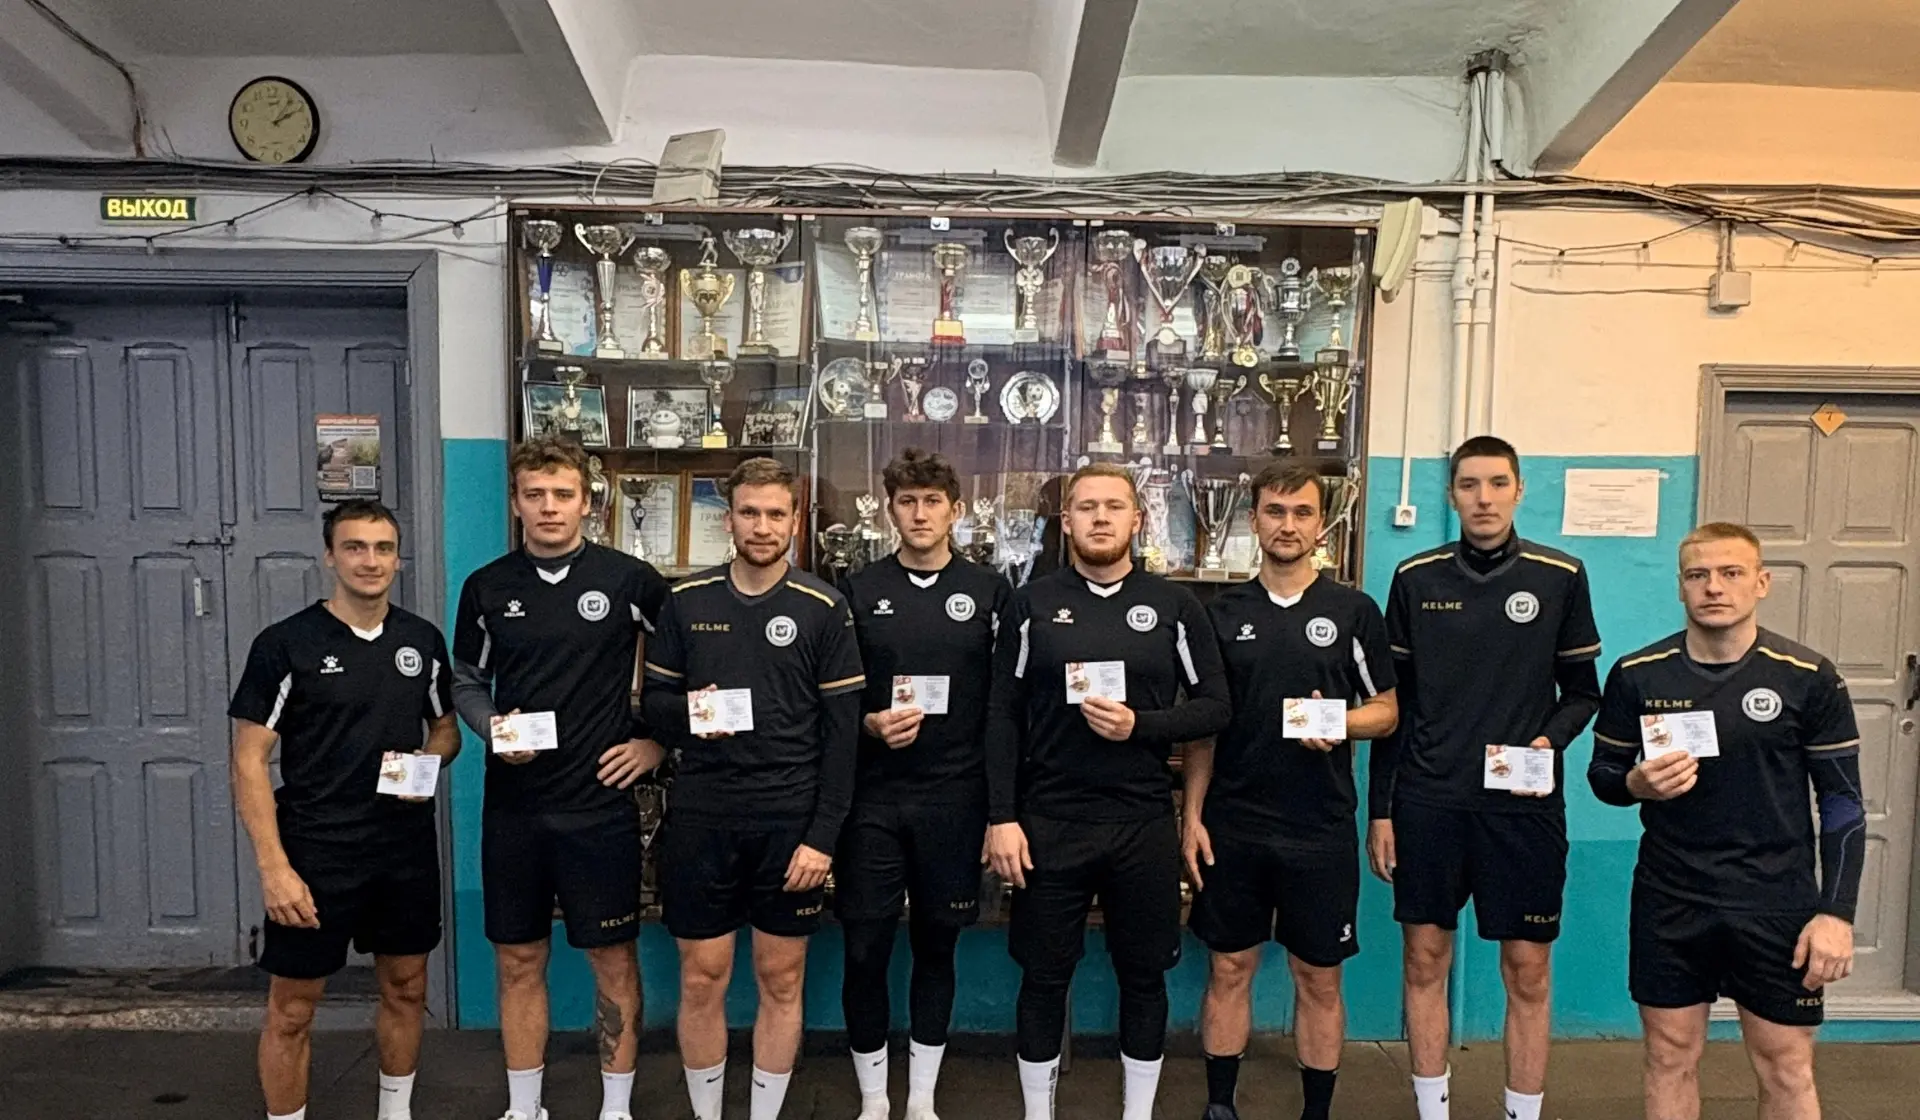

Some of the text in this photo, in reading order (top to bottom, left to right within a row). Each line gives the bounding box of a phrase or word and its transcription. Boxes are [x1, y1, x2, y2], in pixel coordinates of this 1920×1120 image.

[273, 151, 283, 161] 6
[107, 198, 189, 219] ВЫХОД
[1824, 411, 1833, 421] 7
[1421, 601, 1463, 610] KELME
[690, 623, 731, 632] KELME
[1645, 700, 1693, 708] KELME
